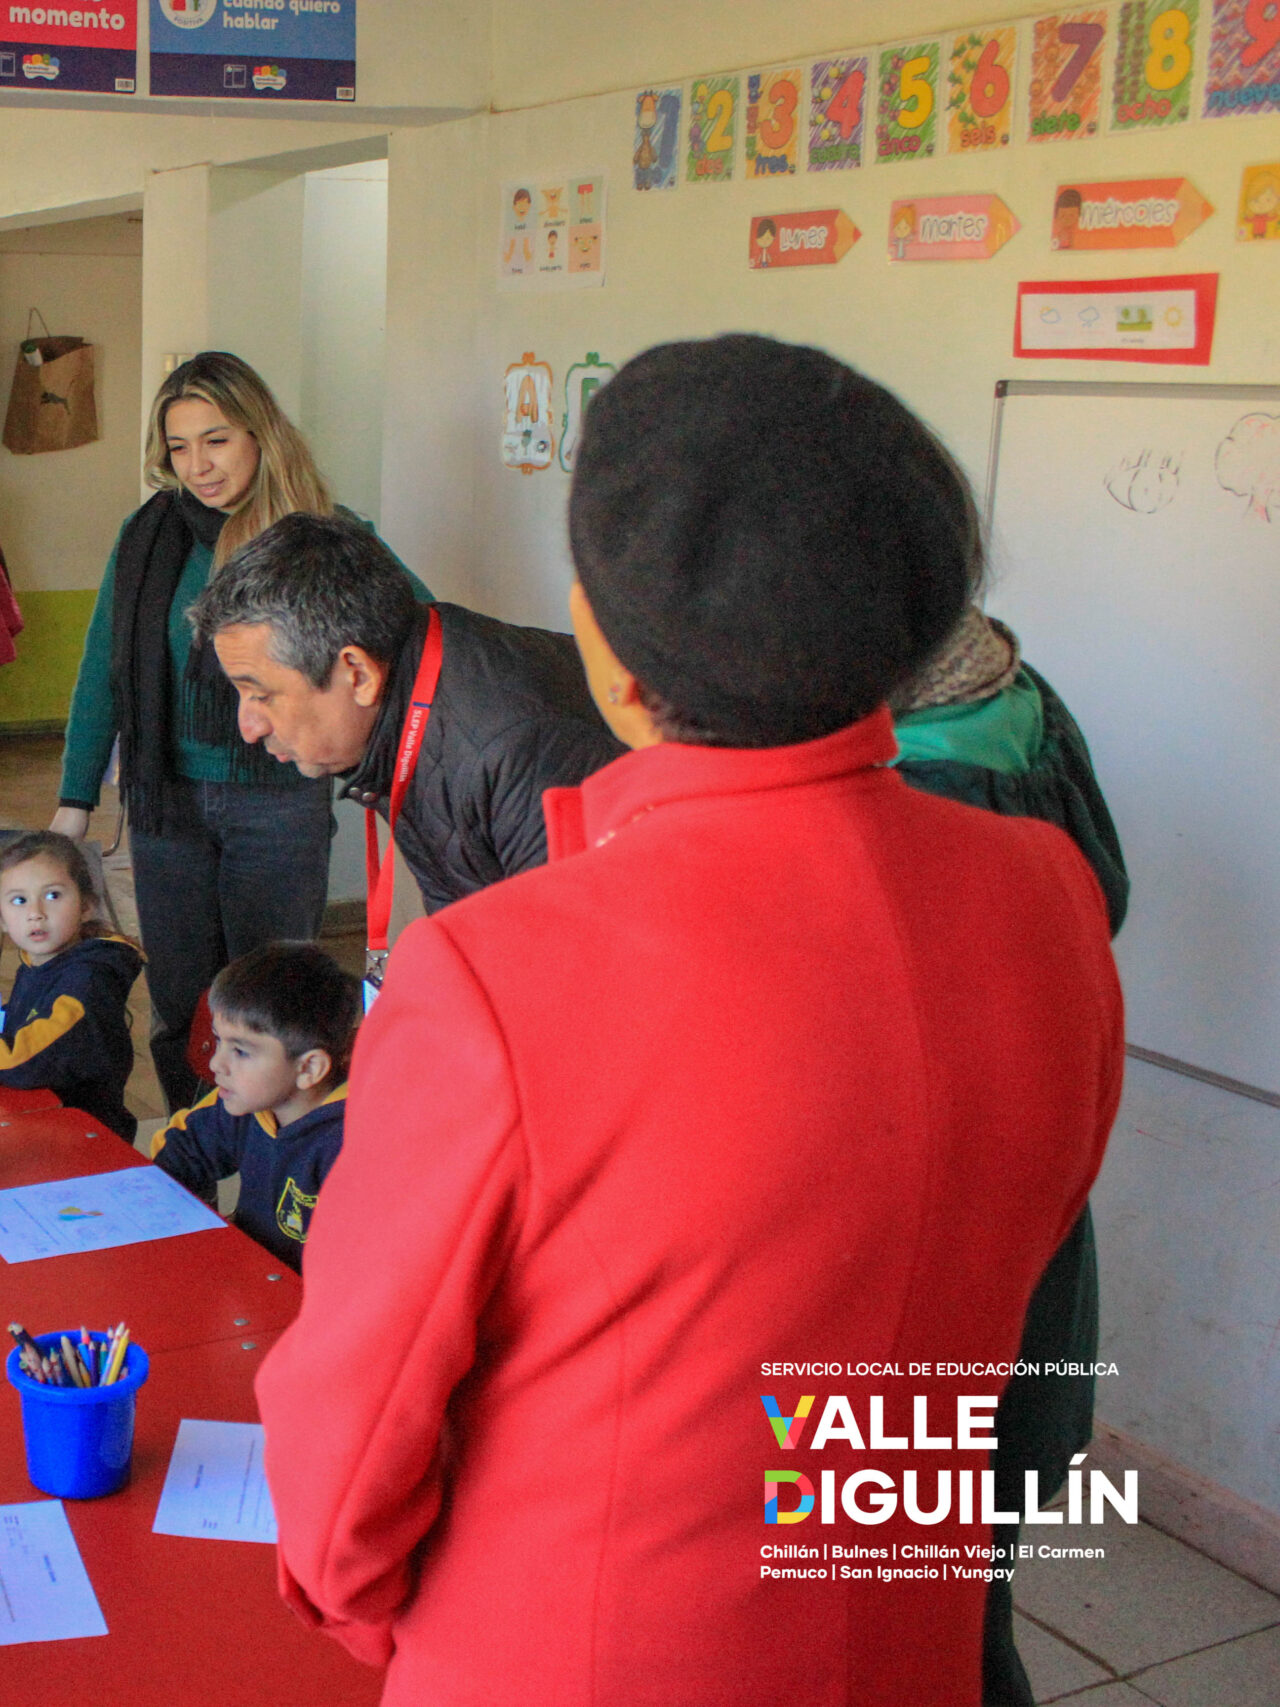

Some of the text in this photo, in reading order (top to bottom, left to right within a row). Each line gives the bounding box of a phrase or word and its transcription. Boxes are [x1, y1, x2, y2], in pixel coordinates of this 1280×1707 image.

[9, 6, 125, 30] momento
[223, 0, 340, 15] cuando quiero
[223, 11, 279, 30] hablar
[1240, 0, 1280, 67] 9
[1052, 23, 1104, 102] 7
[1145, 9, 1192, 91] 8
[897, 56, 933, 128] 5
[970, 39, 1010, 117] 6
[826, 70, 865, 139] 4
[1117, 93, 1171, 122] ocho
[1207, 83, 1280, 110] nueve
[706, 90, 734, 152] 2
[760, 80, 798, 149] 3
[1032, 110, 1081, 136] siete
[658, 95, 681, 169] 1
[960, 121, 995, 147] seis
[695, 154, 724, 176] dos
[754, 153, 789, 175] tres
[515, 374, 539, 424] A
[410, 709, 422, 729] SLEP
[405, 730, 418, 750] Valle
